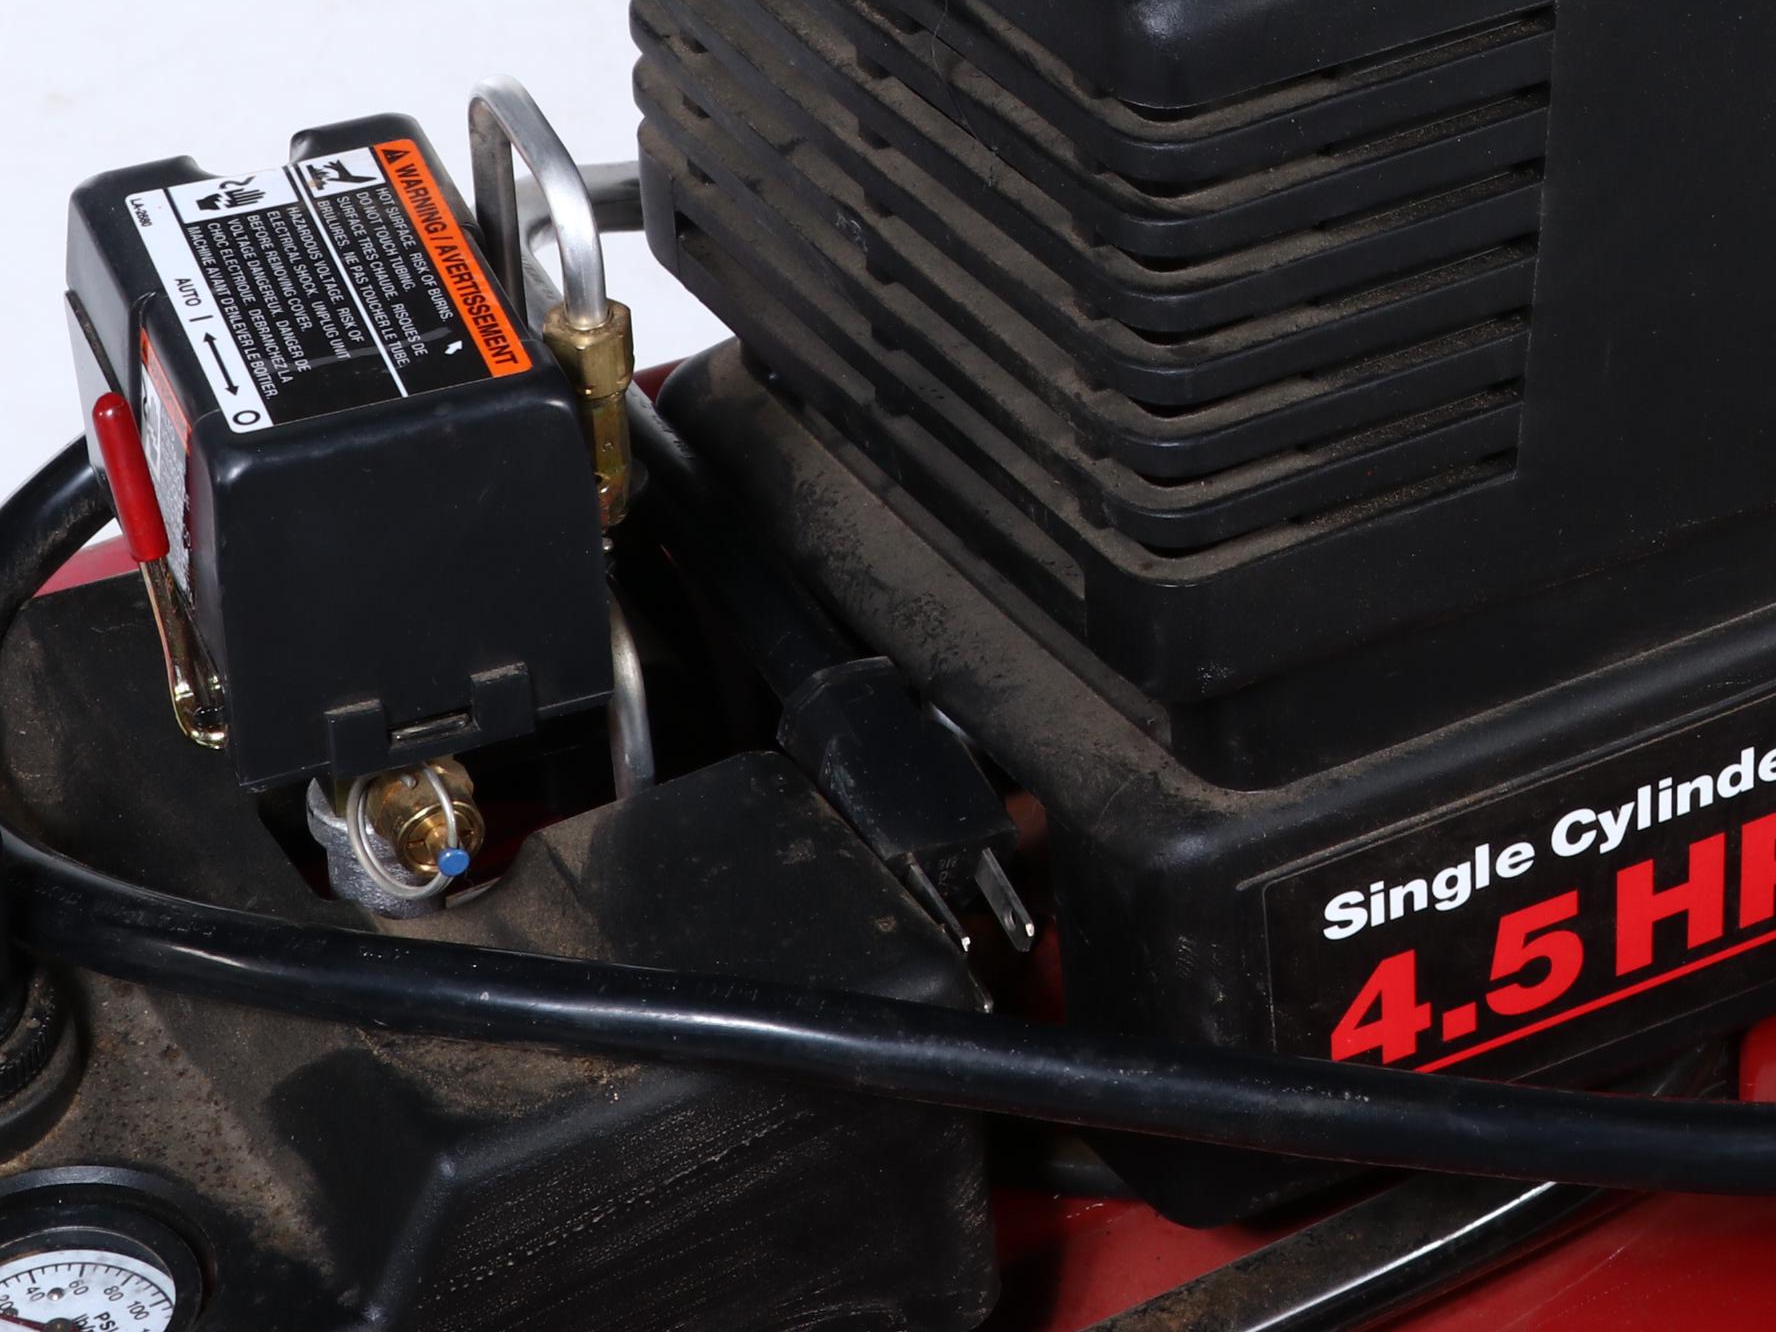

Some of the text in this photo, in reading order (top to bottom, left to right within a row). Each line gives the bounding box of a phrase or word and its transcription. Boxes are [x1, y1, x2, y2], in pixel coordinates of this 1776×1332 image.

[355, 191, 374, 207] DO
[362, 205, 384, 225] NOT
[246, 214, 275, 251] BEFORE
[264, 249, 298, 298] REMOVING
[342, 250, 361, 266] NE
[373, 224, 400, 257] TOUCH
[375, 186, 396, 206] HOT
[408, 251, 431, 275] RISK
[420, 273, 439, 287] OF
[266, 209, 303, 265] ELECTRICAL
[310, 300, 340, 339] UNPLUG
[329, 337, 352, 360] UNIT
[286, 205, 324, 261] HAZARDOUS
[335, 306, 358, 330] RISK
[347, 329, 366, 343] OF
[336, 195, 368, 238] SURFACE
[357, 236, 380, 262] TRES
[390, 302, 422, 344] RISQUES
[410, 342, 429, 357] DE
[349, 264, 370, 285] PAS
[394, 162, 448, 235] WARNING
[433, 244, 519, 365] AVERTISSEMENT
[174, 277, 203, 308] AUTO
[186, 225, 217, 267] MACHINE
[205, 266, 232, 296] AVANT
[243, 346, 262, 361] LE
[206, 221, 230, 249] CHOC
[247, 308, 289, 371] DEBRANCHEZ
[276, 368, 294, 384] LA
[226, 217, 258, 260] VOLTAGE
[275, 319, 305, 359] DANGER
[293, 358, 312, 373] DE
[359, 283, 392, 329] TOUCHER
[380, 327, 399, 342] LE
[1324, 842, 1535, 940] Single
[1331, 890, 1583, 1064] 4.5
[26, 1287, 45, 1301] 40
[68, 1280, 89, 1296] 60
[103, 1285, 124, 1302] 80
[126, 1301, 149, 1320] 100
